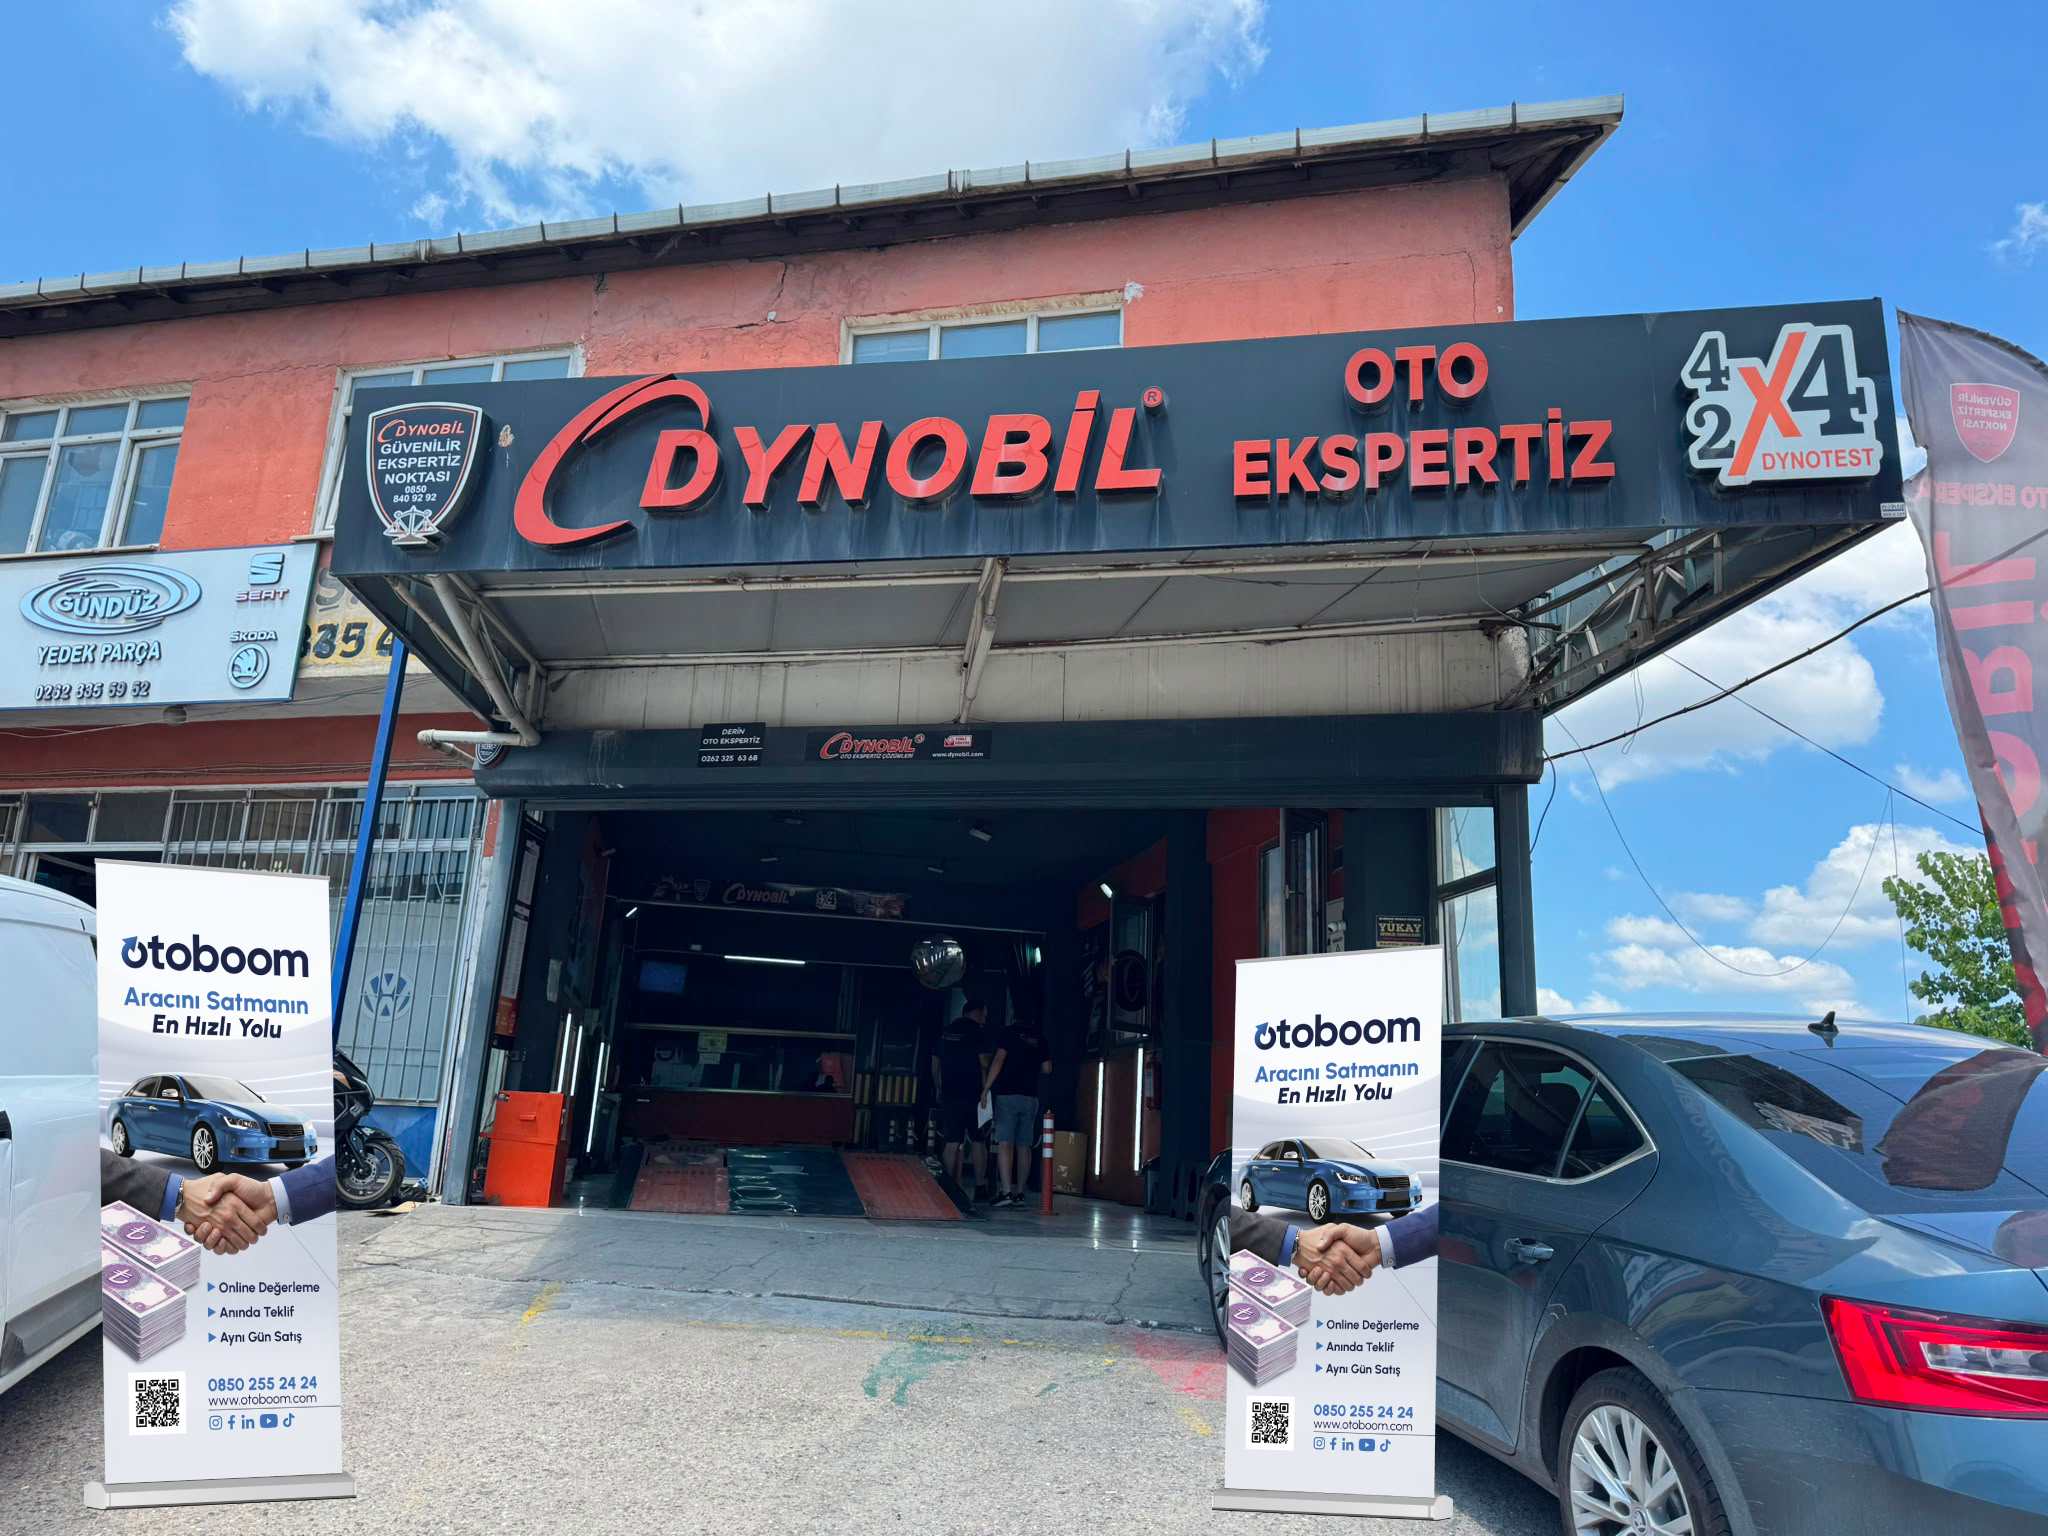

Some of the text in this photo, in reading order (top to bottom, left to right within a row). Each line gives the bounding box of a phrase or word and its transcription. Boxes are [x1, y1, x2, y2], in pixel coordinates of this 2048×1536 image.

[1344, 342, 1489, 404] OTO
[380, 438, 461, 455] GÜVENİLİR
[1233, 408, 1616, 497] EKSPERTİZ
[377, 453, 461, 470] EKSPERTİZ
[1761, 448, 1875, 471] DYNOTEST
[385, 471, 451, 485] NOKTASI
[404, 485, 427, 493] 0850
[393, 493, 437, 503] 840 92 92
[234, 588, 289, 603] SEAT
[55, 589, 161, 619] GÜNDÜZ
[37, 640, 162, 666] YEDEK PARÇA
[34, 681, 152, 702] 0262 335 59 52
[721, 726, 746, 735] DERİN
[720, 736, 761, 744] EKSPERTİZ
[121, 933, 309, 978] otoboom
[124, 987, 309, 1014] Aracını Satmanın
[152, 1014, 282, 1039] En Hızlı Yolu
[1254, 1013, 1421, 1051] otoboom
[1255, 1062, 1419, 1083] Aracını Satmanın
[1278, 1082, 1393, 1104] En Hızlı Yolu
[219, 1281, 320, 1296] Online Değerleme
[220, 1305, 295, 1318] Anında Teklif
[1326, 1319, 1420, 1333] Online Değerleme
[220, 1331, 303, 1346] Aynı Gün Satış
[1326, 1341, 1395, 1352] Anında Teklif
[1326, 1363, 1401, 1377] Aynı Gün Satış
[208, 1376, 318, 1392] 0850 255 24 24
[208, 1393, 318, 1406] www.otoboom.com
[1313, 1404, 1413, 1419] 0850 255 24 24
[1313, 1420, 1413, 1432] www.otoboom.com
